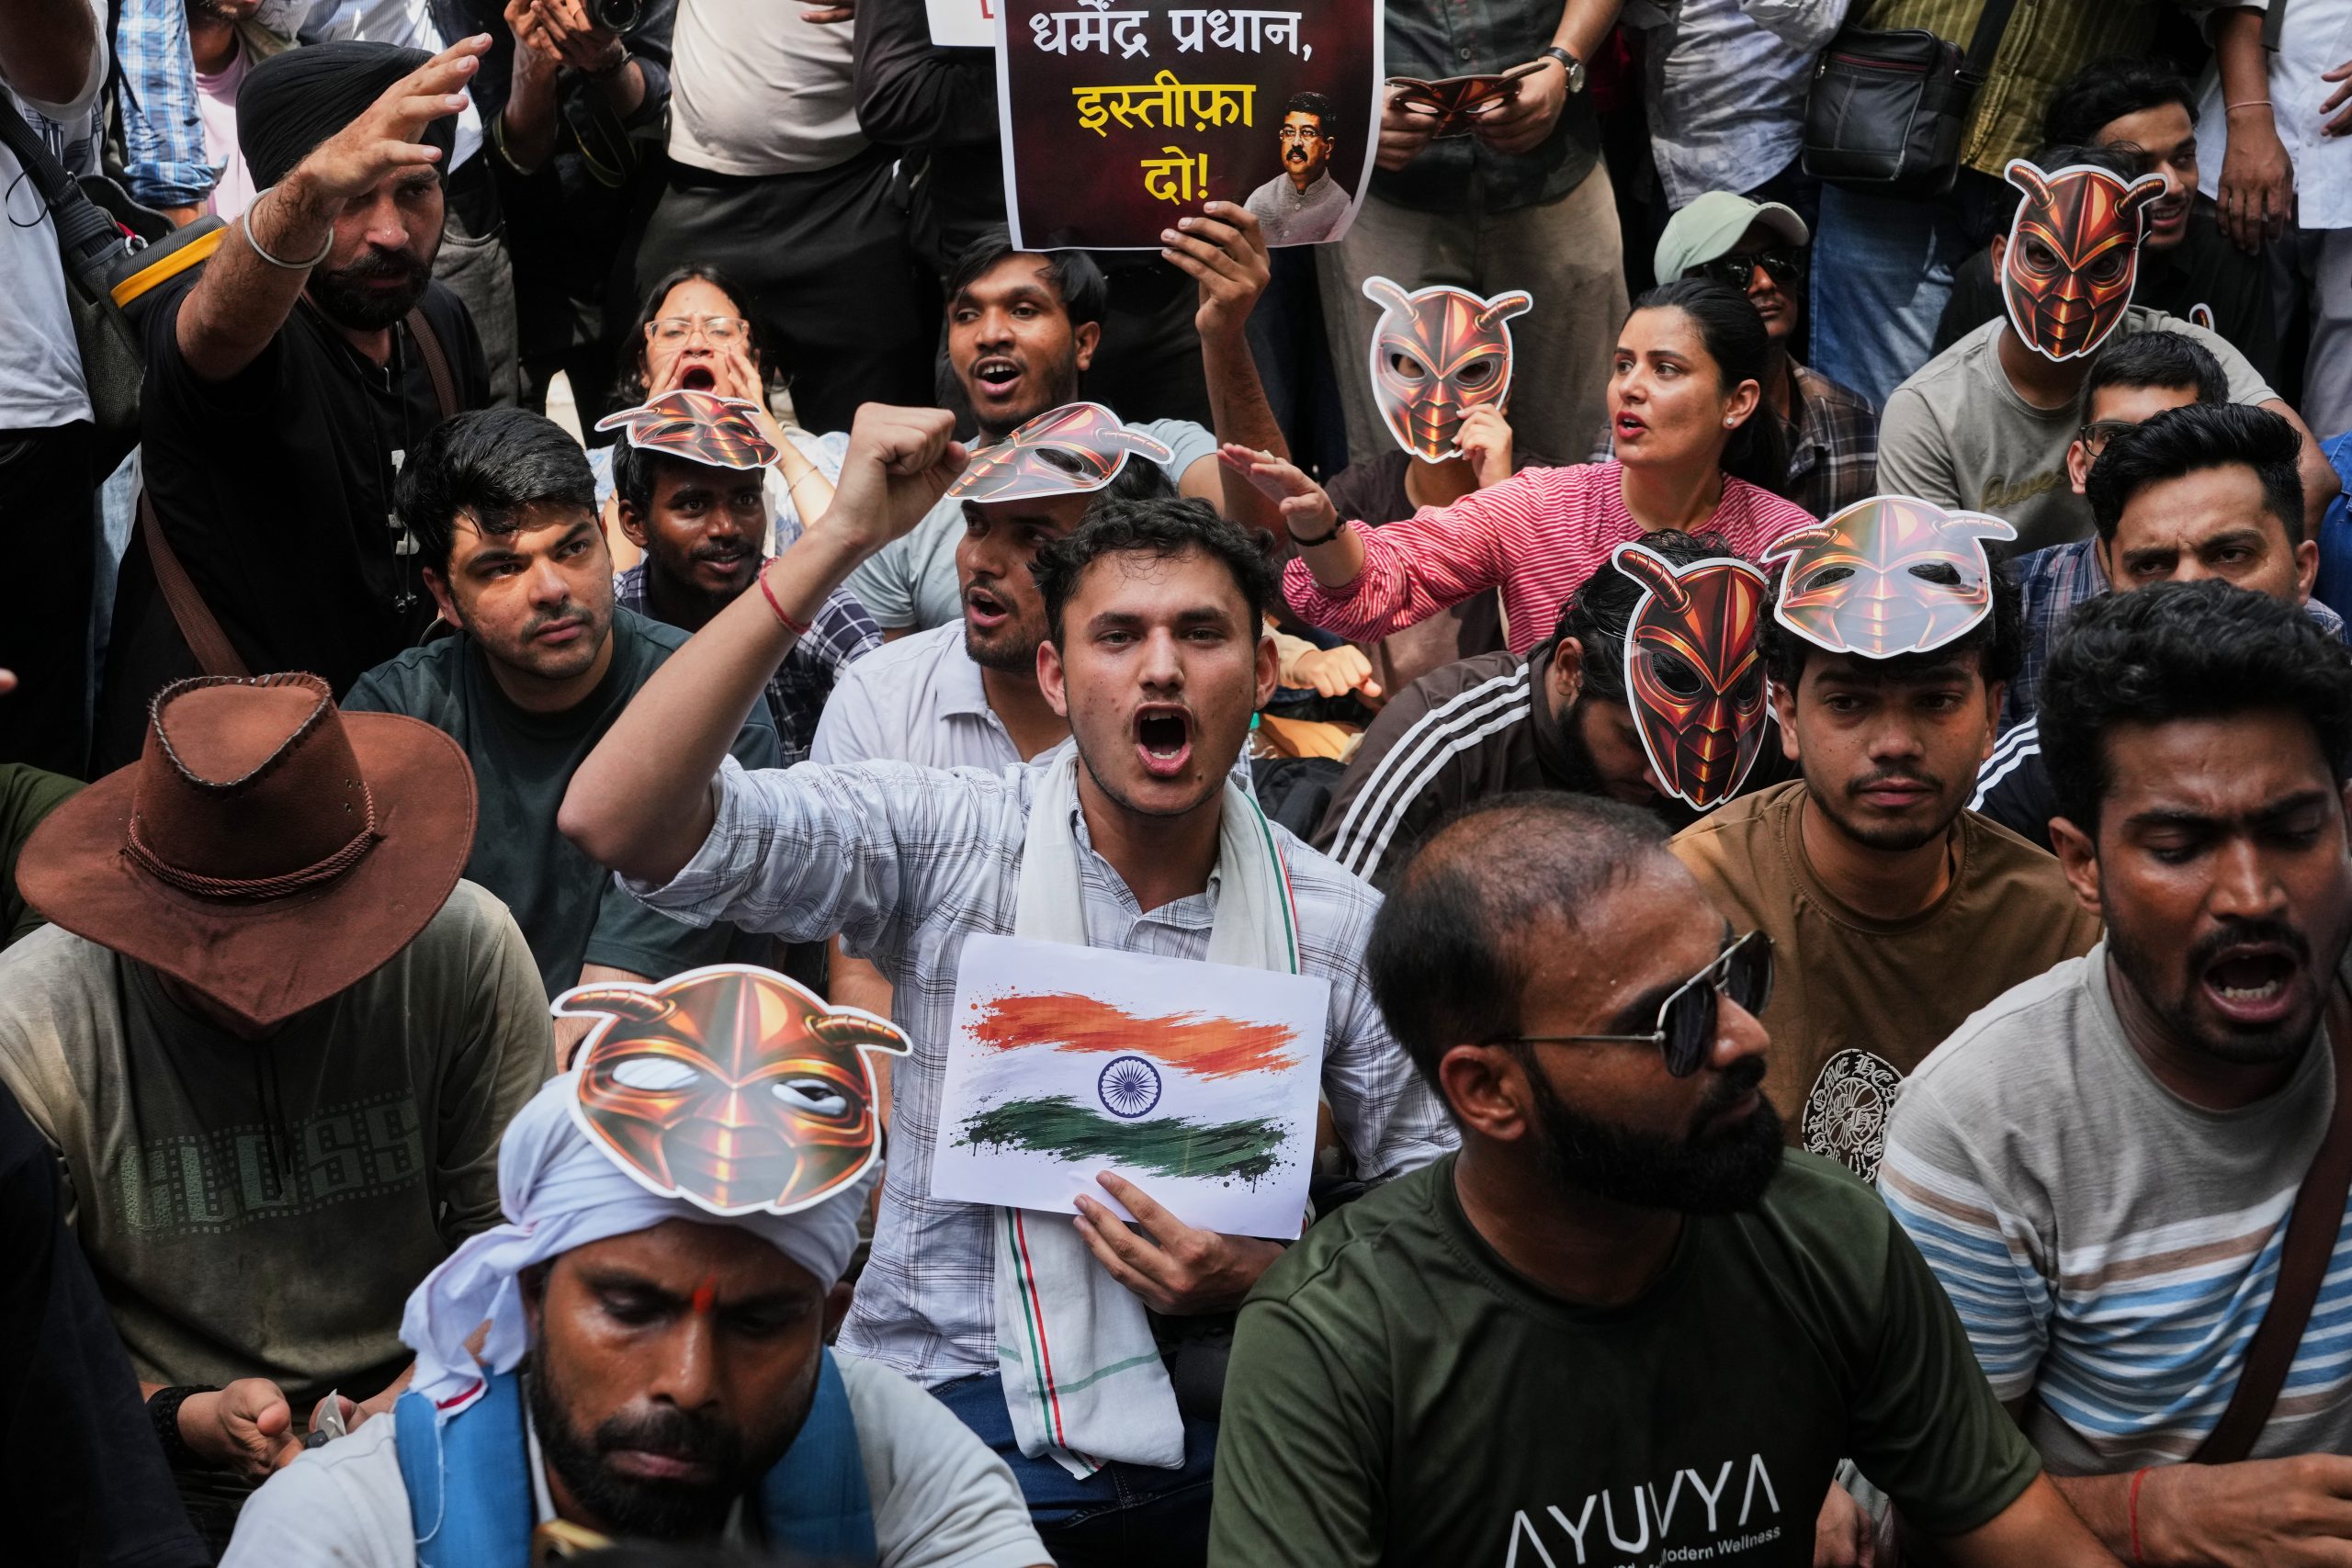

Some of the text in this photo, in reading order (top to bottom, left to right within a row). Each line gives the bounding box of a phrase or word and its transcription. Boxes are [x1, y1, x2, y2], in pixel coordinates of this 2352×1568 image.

[1168, 9, 1313, 61] प्रधान,
[1072, 70, 1256, 137] इस्तीफ़ा
[1141, 145, 1208, 205] दो!
[1717, 1526, 1781, 1555] Wellness
